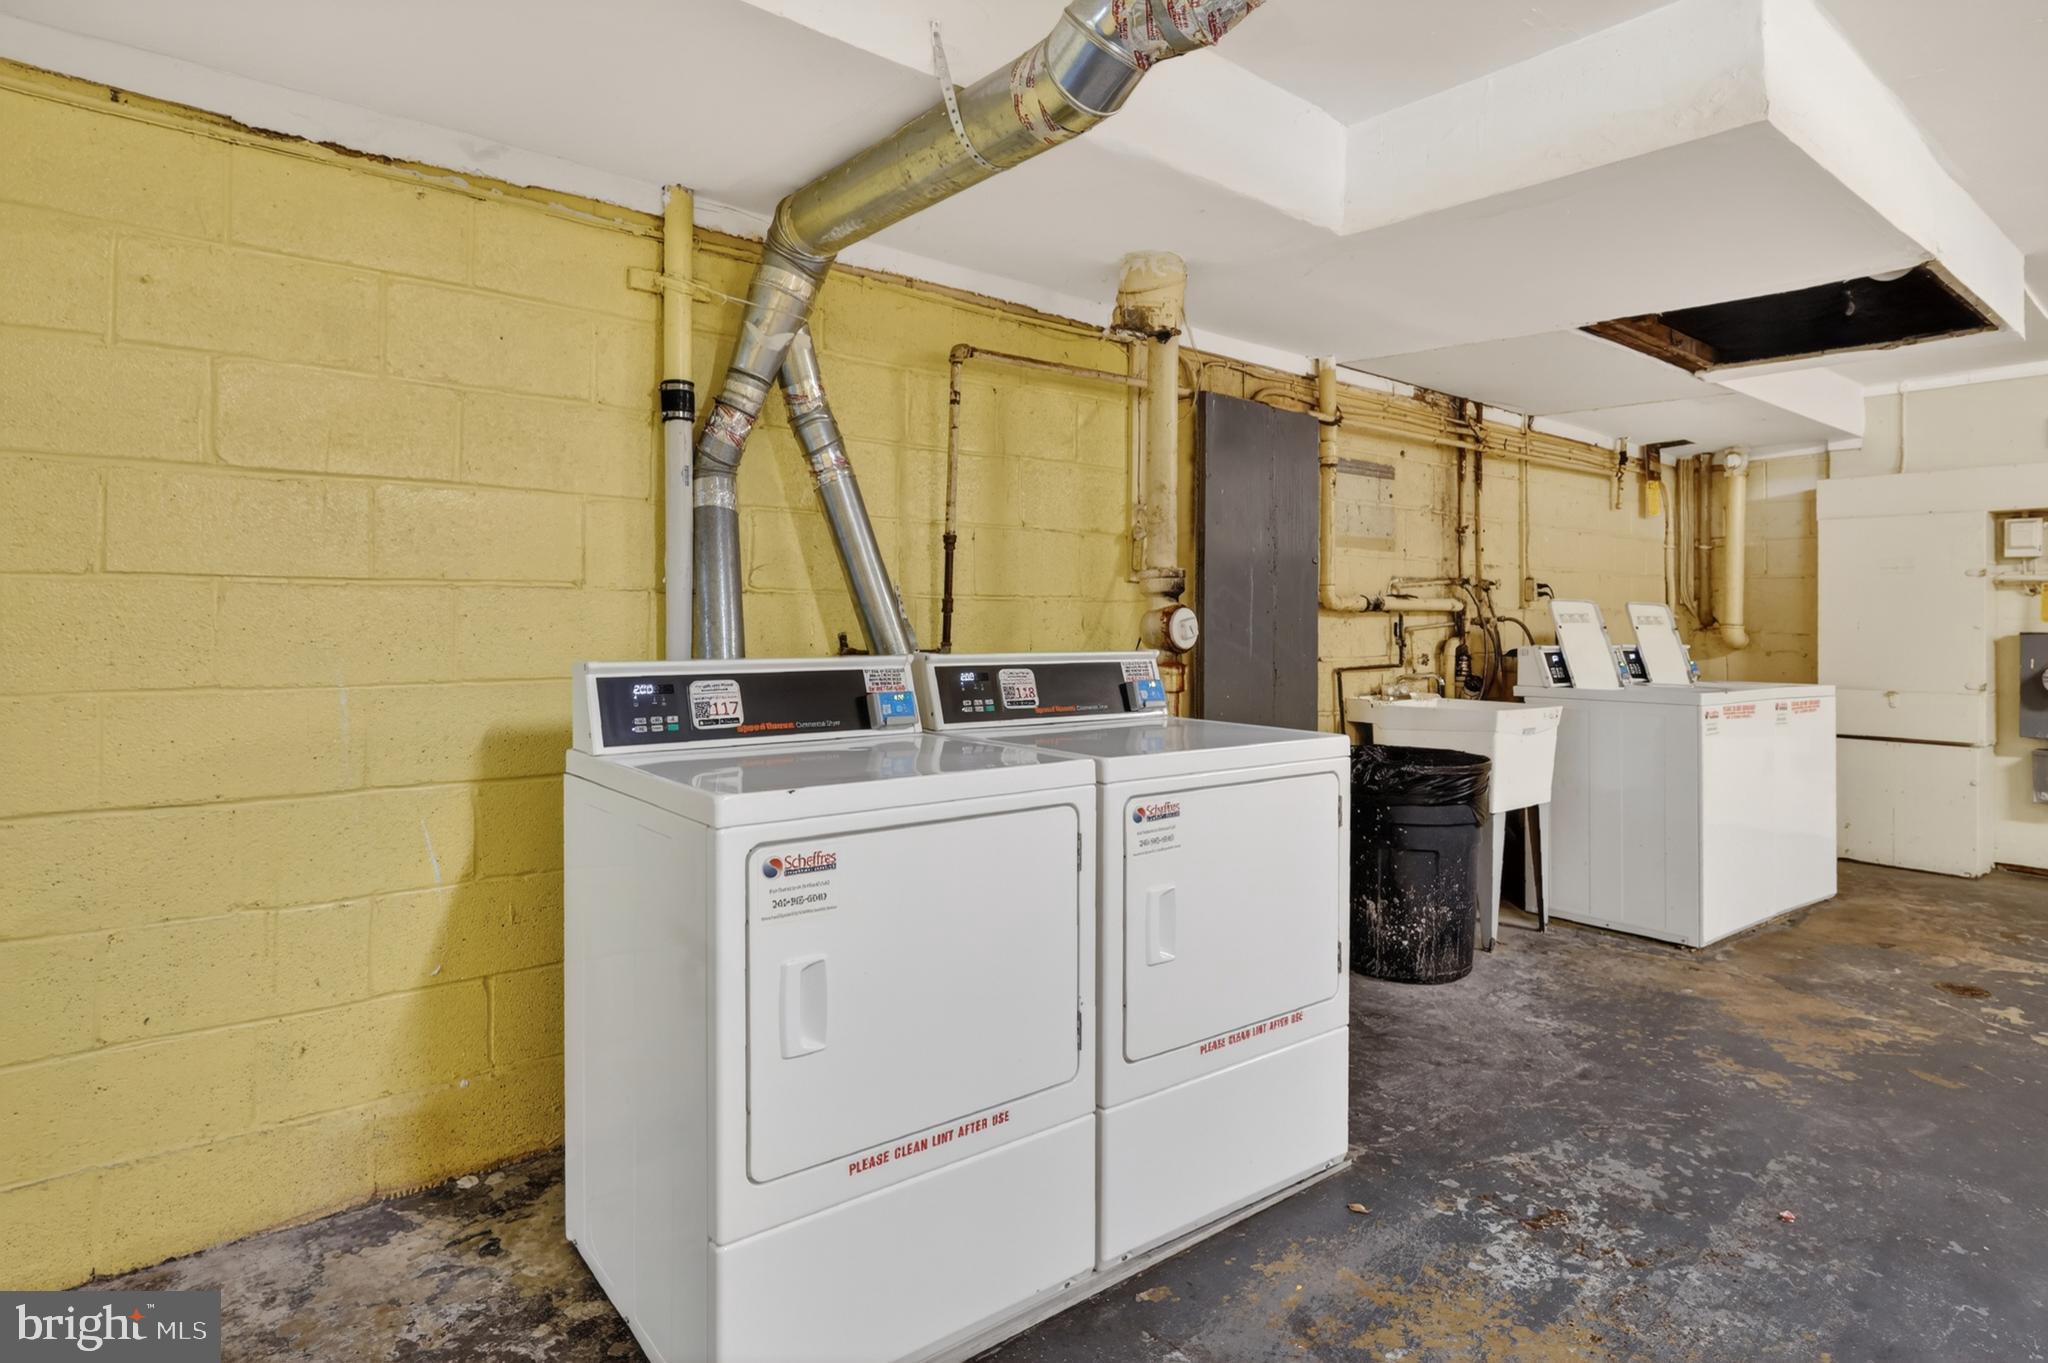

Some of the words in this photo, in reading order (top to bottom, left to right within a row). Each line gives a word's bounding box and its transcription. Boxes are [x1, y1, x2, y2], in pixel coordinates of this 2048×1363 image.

[712, 701, 738, 715] 117
[784, 851, 837, 869] Scheffres
[1200, 1037, 1226, 1055] PLEASE
[1252, 1023, 1267, 1037] LINT
[1269, 1016, 1289, 1030] AFTER
[848, 1151, 890, 1176] PLEASE
[894, 1138, 928, 1160] CLEAN
[932, 1129, 954, 1147] LINT
[957, 1118, 988, 1138] AFTER
[992, 1110, 1010, 1126] USE
